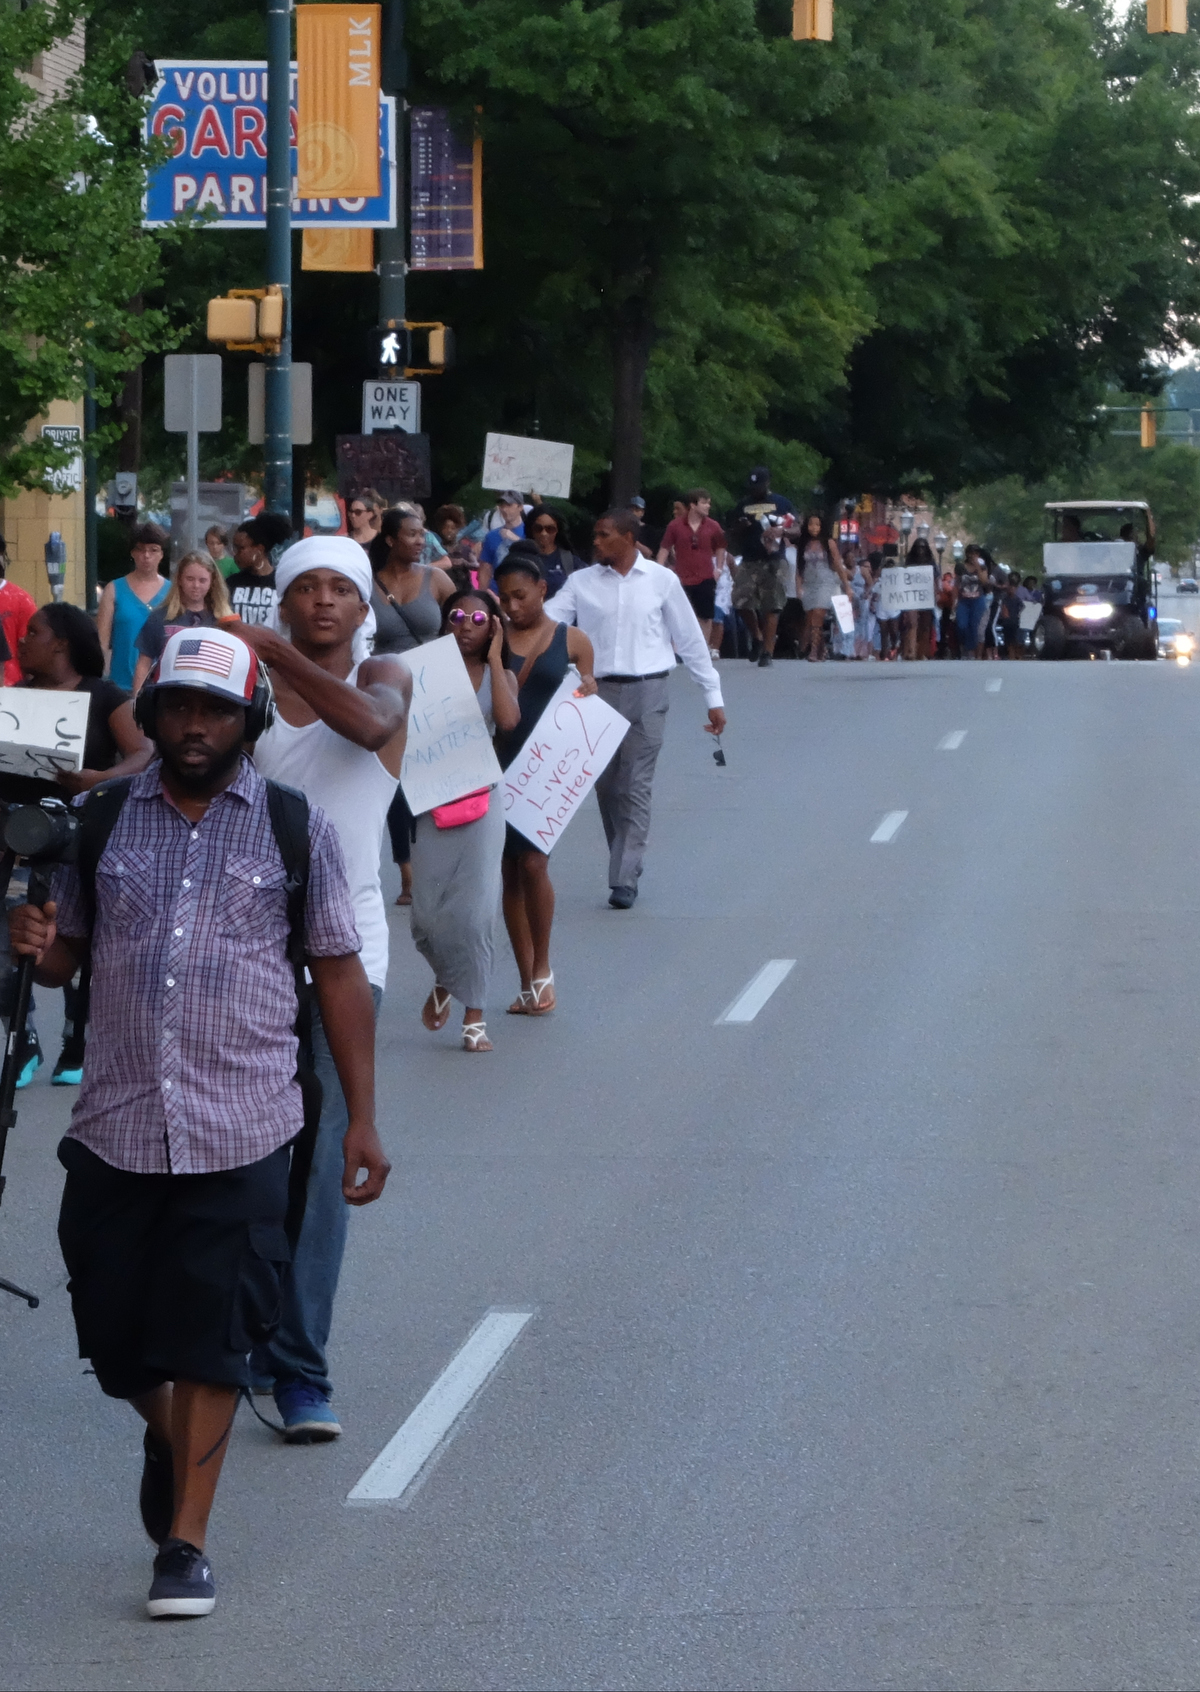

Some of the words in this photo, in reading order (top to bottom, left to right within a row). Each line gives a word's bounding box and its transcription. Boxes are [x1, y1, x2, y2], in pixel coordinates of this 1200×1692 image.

[349, 17, 372, 87] MLK
[371, 405, 410, 421] WAY
[373, 387, 409, 402] ONE
[412, 666, 426, 698] Y
[410, 696, 458, 734] IFE
[554, 701, 611, 757] 2
[404, 720, 488, 774] MATTERS
[527, 747, 580, 811] Lives
[536, 760, 593, 847] Matter
